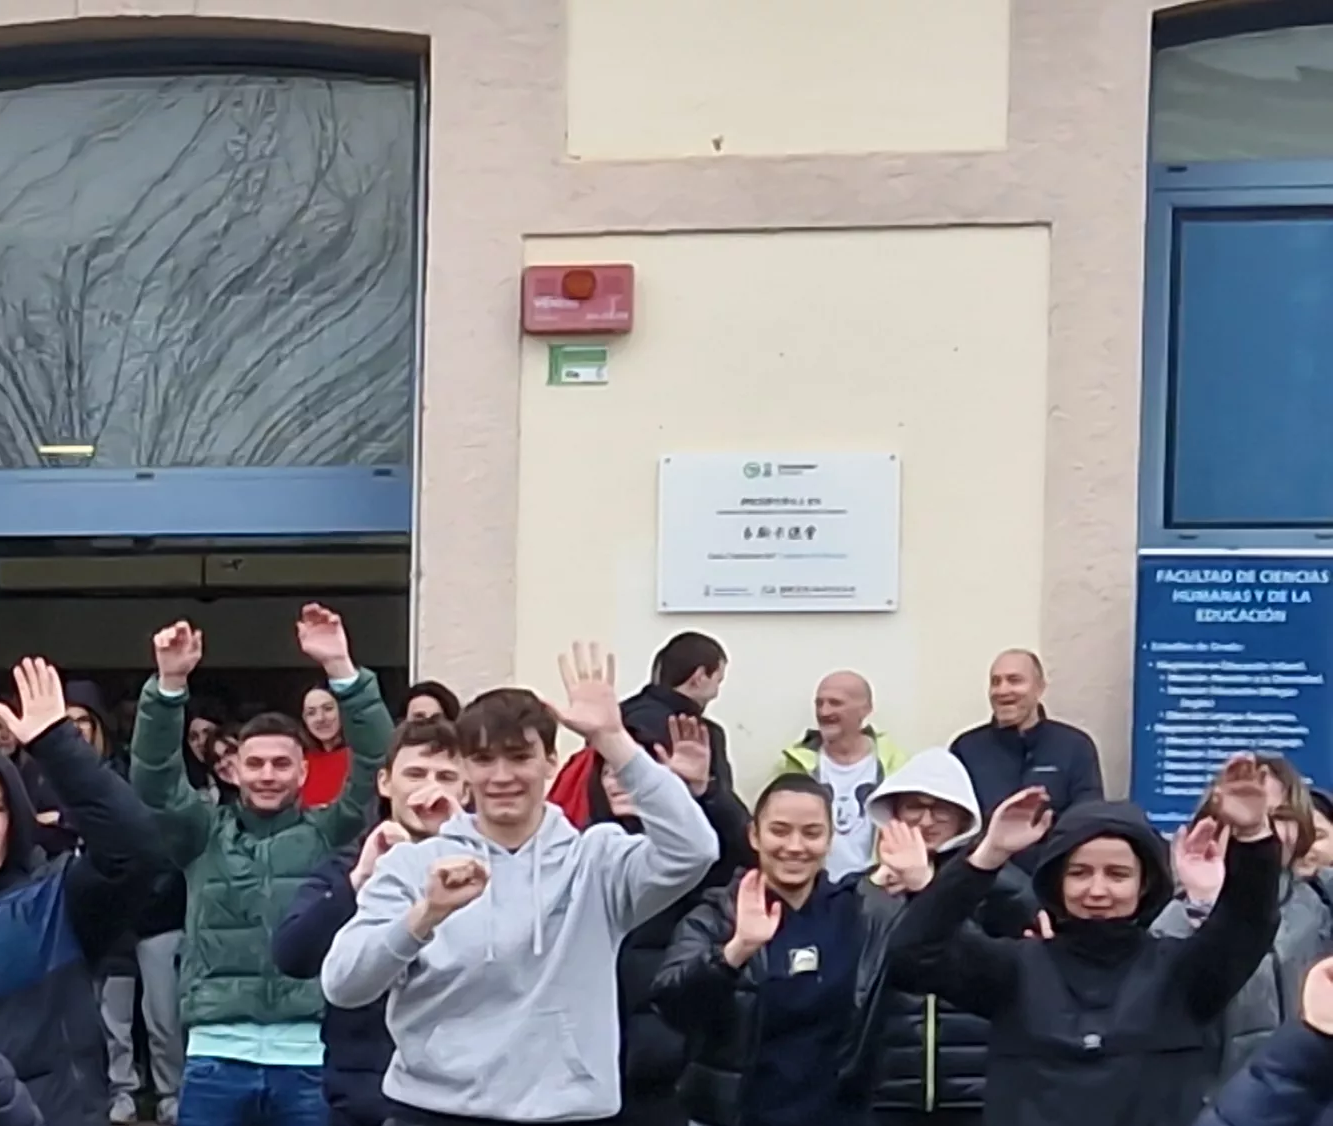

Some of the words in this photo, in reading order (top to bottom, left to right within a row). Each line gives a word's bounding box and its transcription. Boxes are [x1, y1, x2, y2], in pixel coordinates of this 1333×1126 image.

[1156, 569, 1233, 583] FACULTAD
[1236, 569, 1256, 583] DE
[1260, 570, 1330, 583] CIENCIAS
[1172, 589, 1251, 602] HUMANAS
[1254, 590, 1265, 602] Y
[1267, 589, 1288, 602] DE
[1292, 590, 1312, 602] LA
[1196, 606, 1287, 622] EDUCACIÓN
